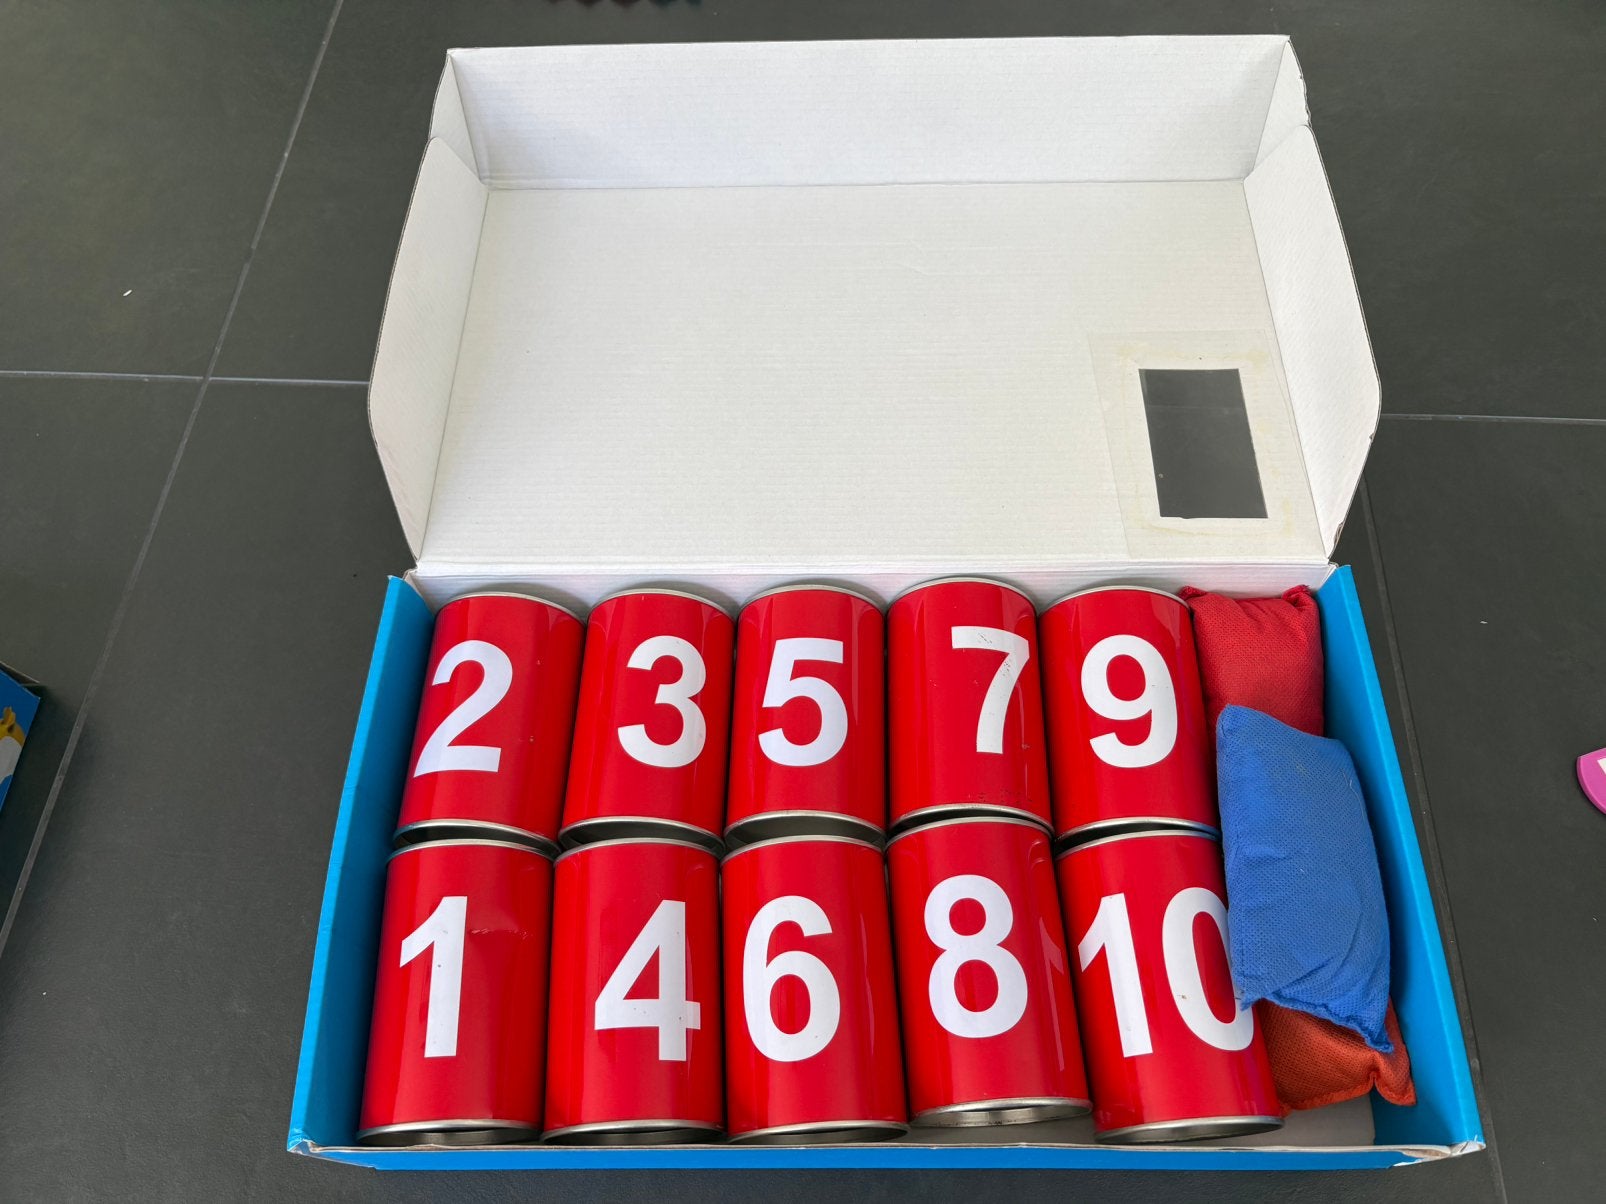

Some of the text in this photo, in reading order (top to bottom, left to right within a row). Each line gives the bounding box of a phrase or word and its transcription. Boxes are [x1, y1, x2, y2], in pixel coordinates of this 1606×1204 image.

[413, 640, 513, 777] 2
[617, 635, 707, 769] 3
[758, 637, 849, 767] 5
[951, 625, 1030, 756] 7
[1081, 634, 1179, 770] 9
[399, 896, 468, 1059] 1
[594, 899, 701, 1063] 4
[742, 895, 841, 1063] 6
[924, 874, 1029, 1039] 8
[1078, 886, 1255, 1058] 10
